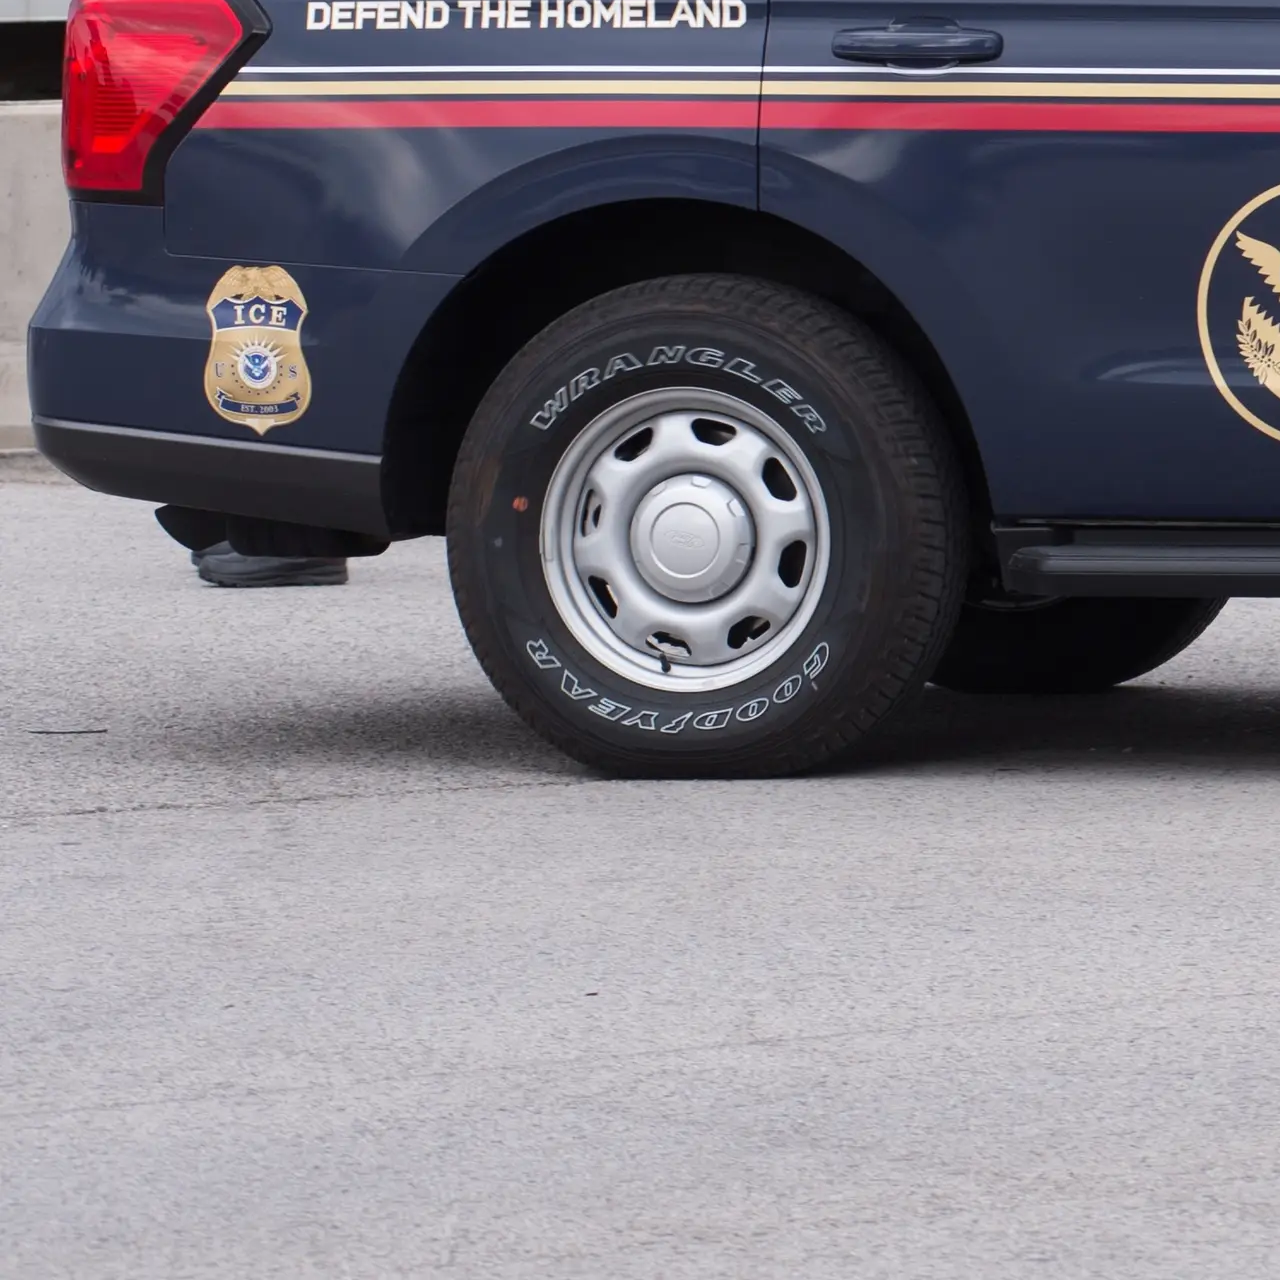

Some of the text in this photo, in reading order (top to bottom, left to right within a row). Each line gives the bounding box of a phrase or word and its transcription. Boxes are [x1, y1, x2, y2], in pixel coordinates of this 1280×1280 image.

[306, 0, 747, 30] DEFEND THE HOMELAND
[233, 303, 287, 327] ICE
[529, 345, 828, 434] WRANGLER
[526, 629, 830, 734] GOODYEAR
